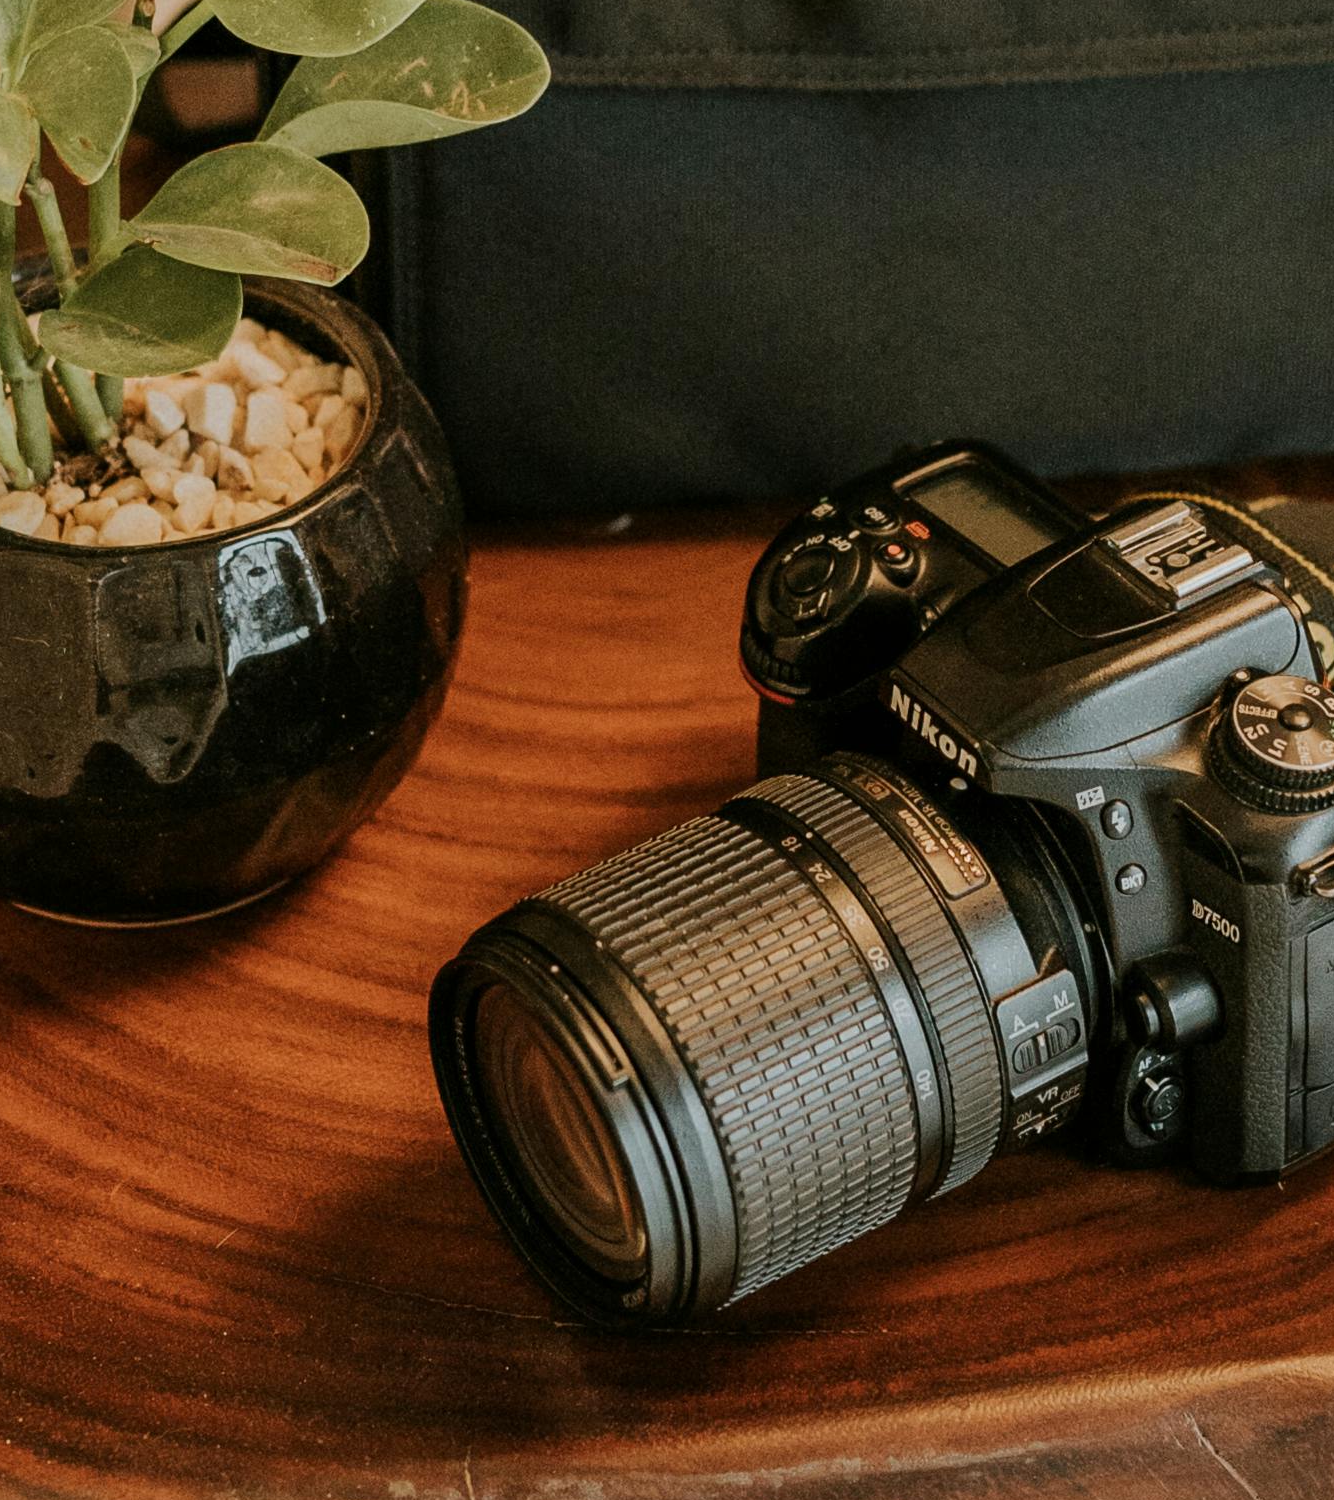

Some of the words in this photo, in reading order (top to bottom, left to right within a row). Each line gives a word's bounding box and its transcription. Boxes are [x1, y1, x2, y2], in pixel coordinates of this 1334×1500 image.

[1304, 684, 1321, 696] S
[1238, 703, 1278, 720] EFFECTS
[890, 684, 977, 778] Nikon
[1243, 723, 1270, 740] U2
[1267, 738, 1288, 758] U1
[897, 808, 939, 853] Nikon
[781, 836, 802, 852] 18
[808, 862, 832, 883] 24
[1120, 872, 1144, 891] BKT
[1192, 898, 1240, 944] D7500
[867, 946, 889, 972] 50
[1052, 990, 1069, 1010] M
[1013, 1014, 1026, 1032] A
[1138, 1055, 1152, 1072] AF
[916, 1068, 935, 1101] 140
[1060, 1083, 1081, 1101] OFF
[1036, 1086, 1059, 1104] VR
[1017, 1109, 1032, 1125] ON
